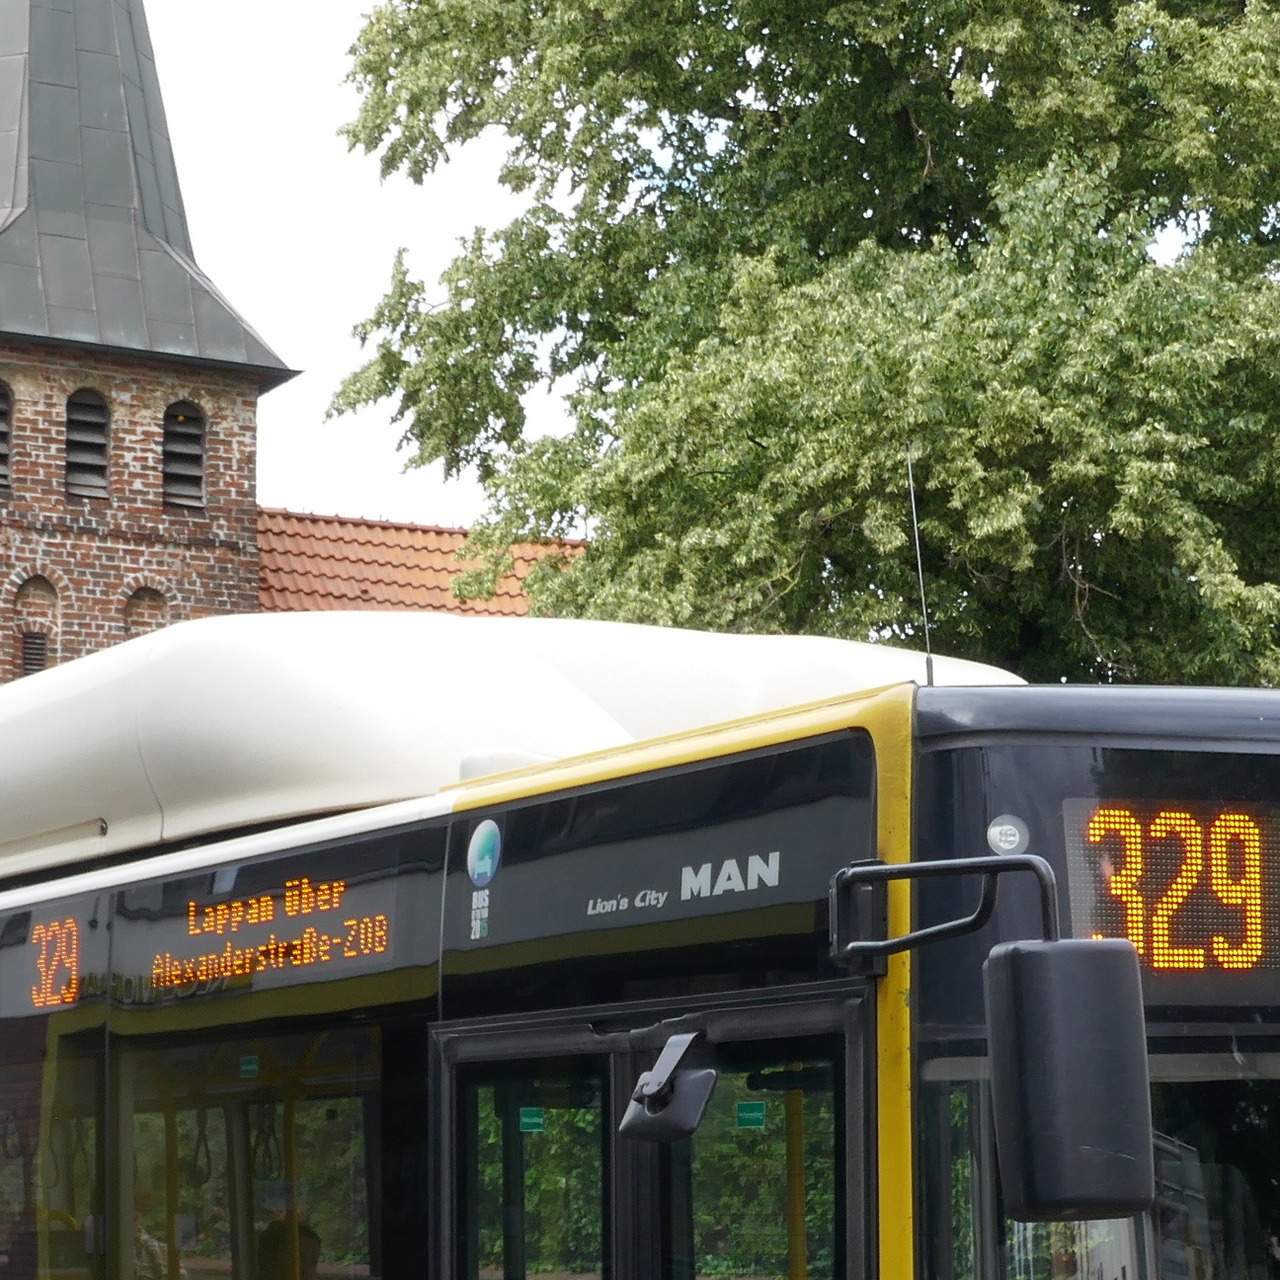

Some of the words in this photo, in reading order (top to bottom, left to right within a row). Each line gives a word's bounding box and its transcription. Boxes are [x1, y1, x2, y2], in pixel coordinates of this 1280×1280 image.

[188, 896, 274, 936] Lappan
[284, 877, 346, 917] über
[587, 895, 628, 915] Lion's
[634, 889, 668, 909] City
[680, 851, 780, 901] MAN
[1086, 808, 1263, 970] 329
[31, 918, 79, 1007] 329
[151, 914, 388, 988] Alexanderstraße-ZOB
